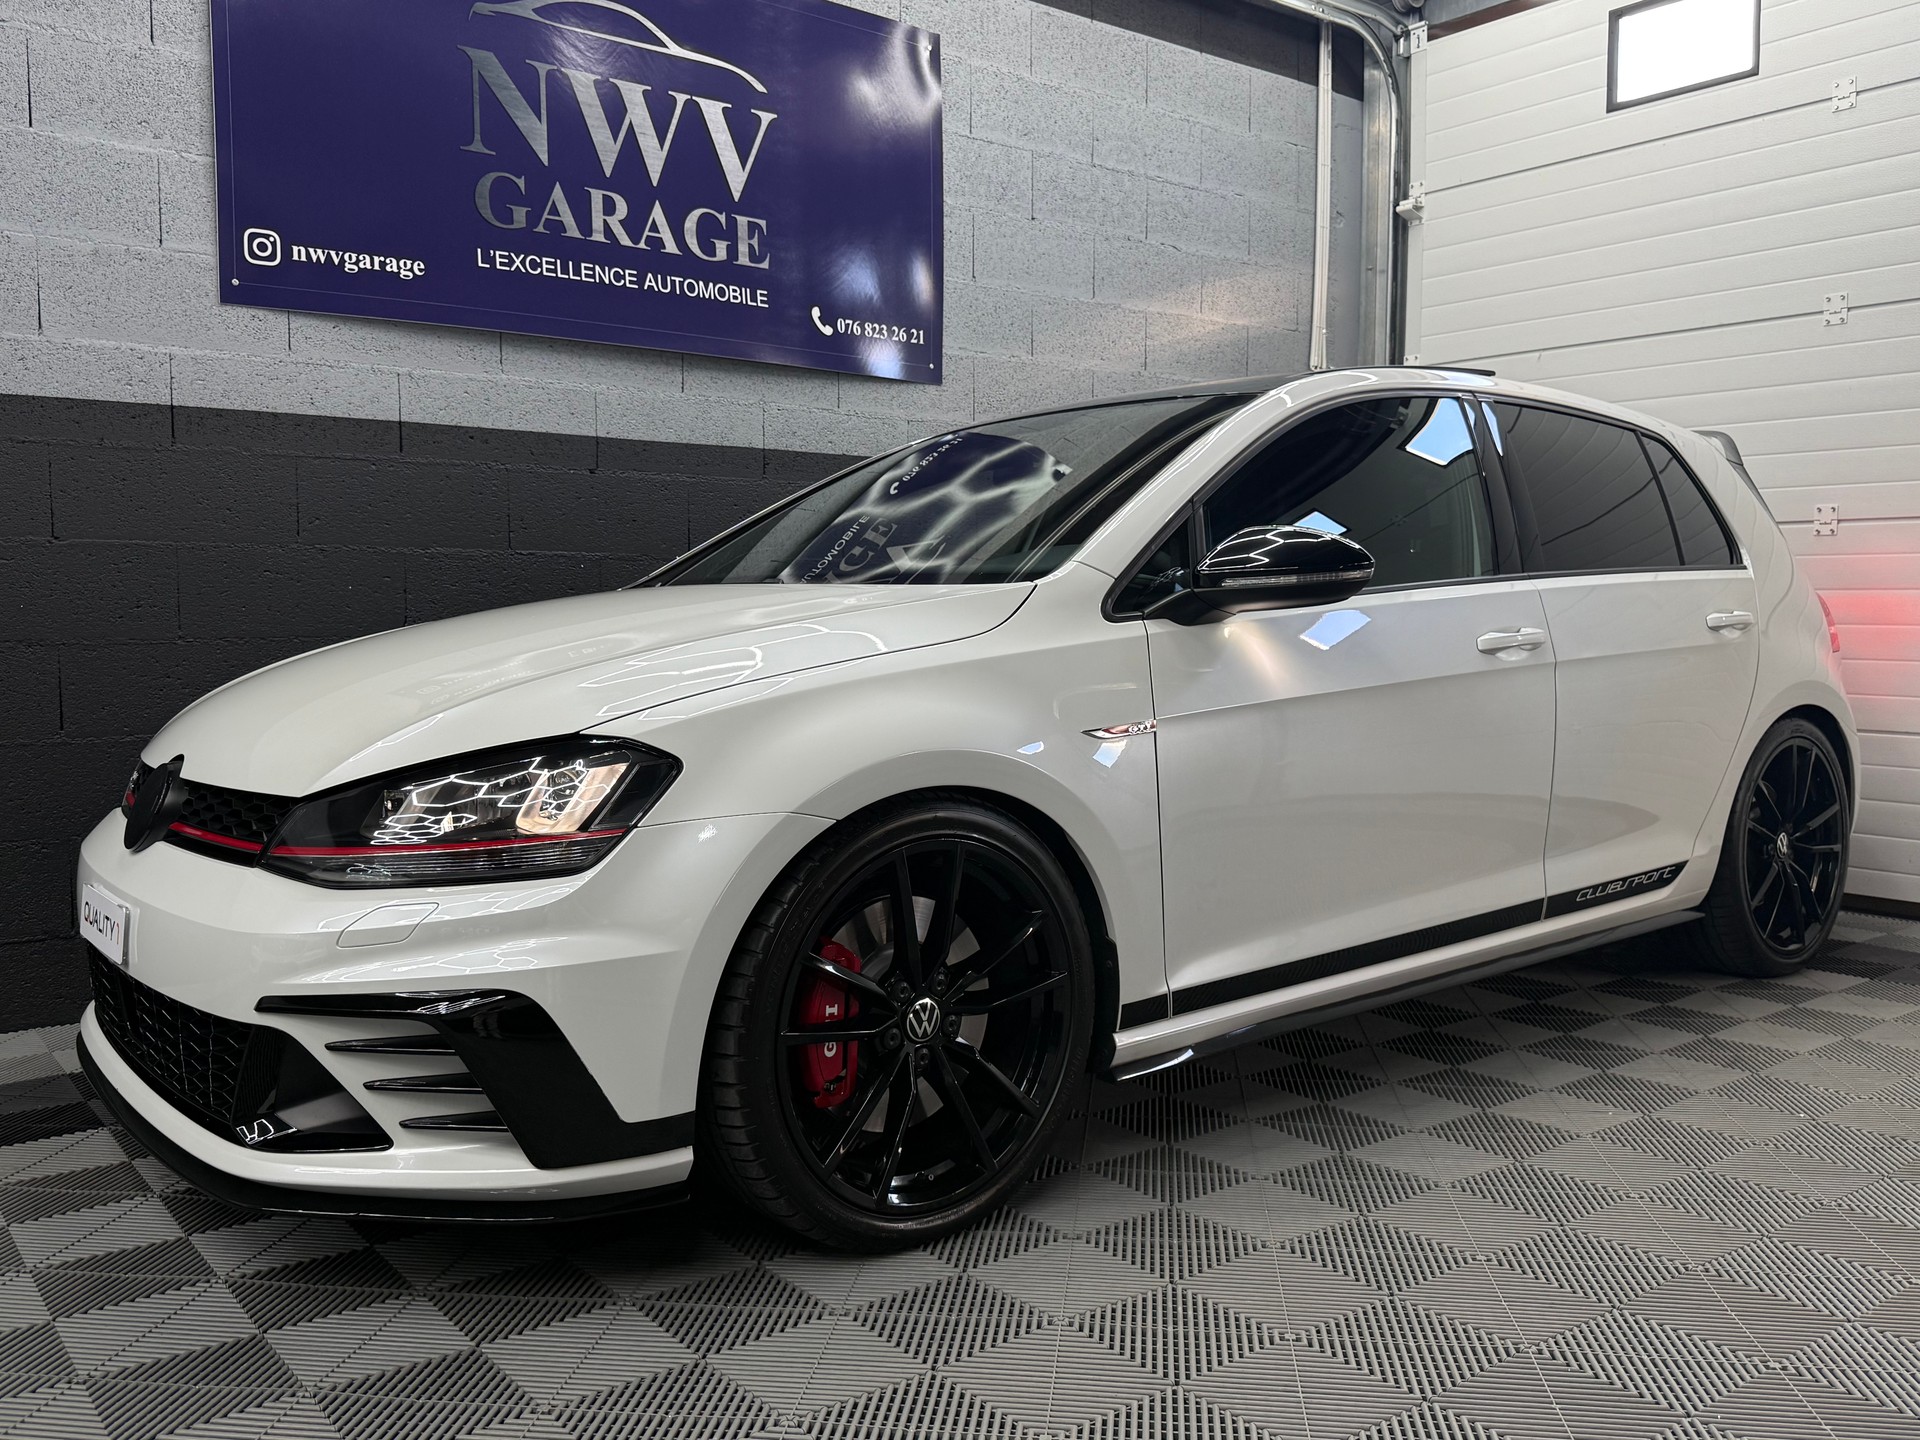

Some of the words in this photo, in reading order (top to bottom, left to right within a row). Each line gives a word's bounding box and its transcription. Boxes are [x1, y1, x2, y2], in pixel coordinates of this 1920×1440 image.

[457, 45, 778, 203] NWV
[475, 171, 770, 270] GARAGE
[291, 244, 426, 280] nwvgarage
[477, 248, 639, 289] L'EXCELLENCE
[643, 272, 770, 308] AUTOMOBILE
[837, 318, 861, 336] 076
[864, 322, 888, 339] 823
[891, 326, 907, 342] 26
[910, 329, 925, 345] 21
[824, 1003, 838, 1058] GI
